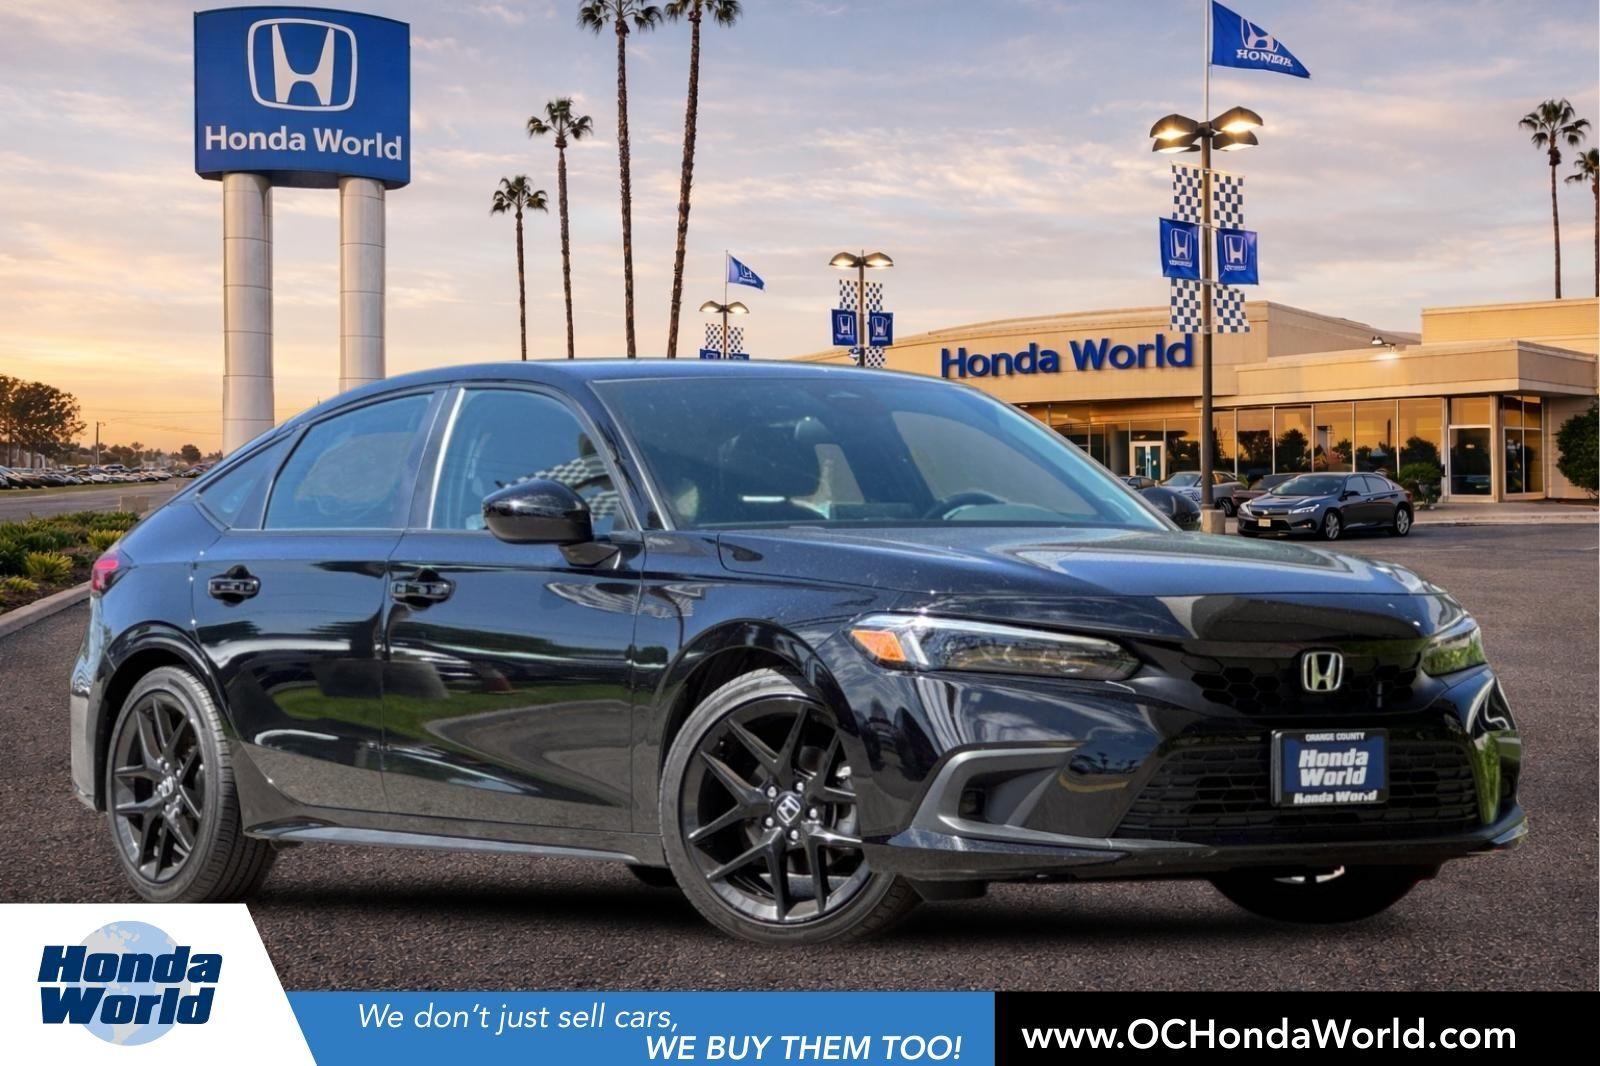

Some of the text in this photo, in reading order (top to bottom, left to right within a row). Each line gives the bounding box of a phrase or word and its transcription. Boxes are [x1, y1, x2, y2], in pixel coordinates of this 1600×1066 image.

[205, 125, 402, 161] Honda World
[941, 333, 1194, 378] Honda World
[1305, 732, 1365, 742] ORANGE COUNTY
[1299, 748, 1369, 768] Honda
[1300, 767, 1367, 787] World
[1293, 792, 1334, 804] Honda
